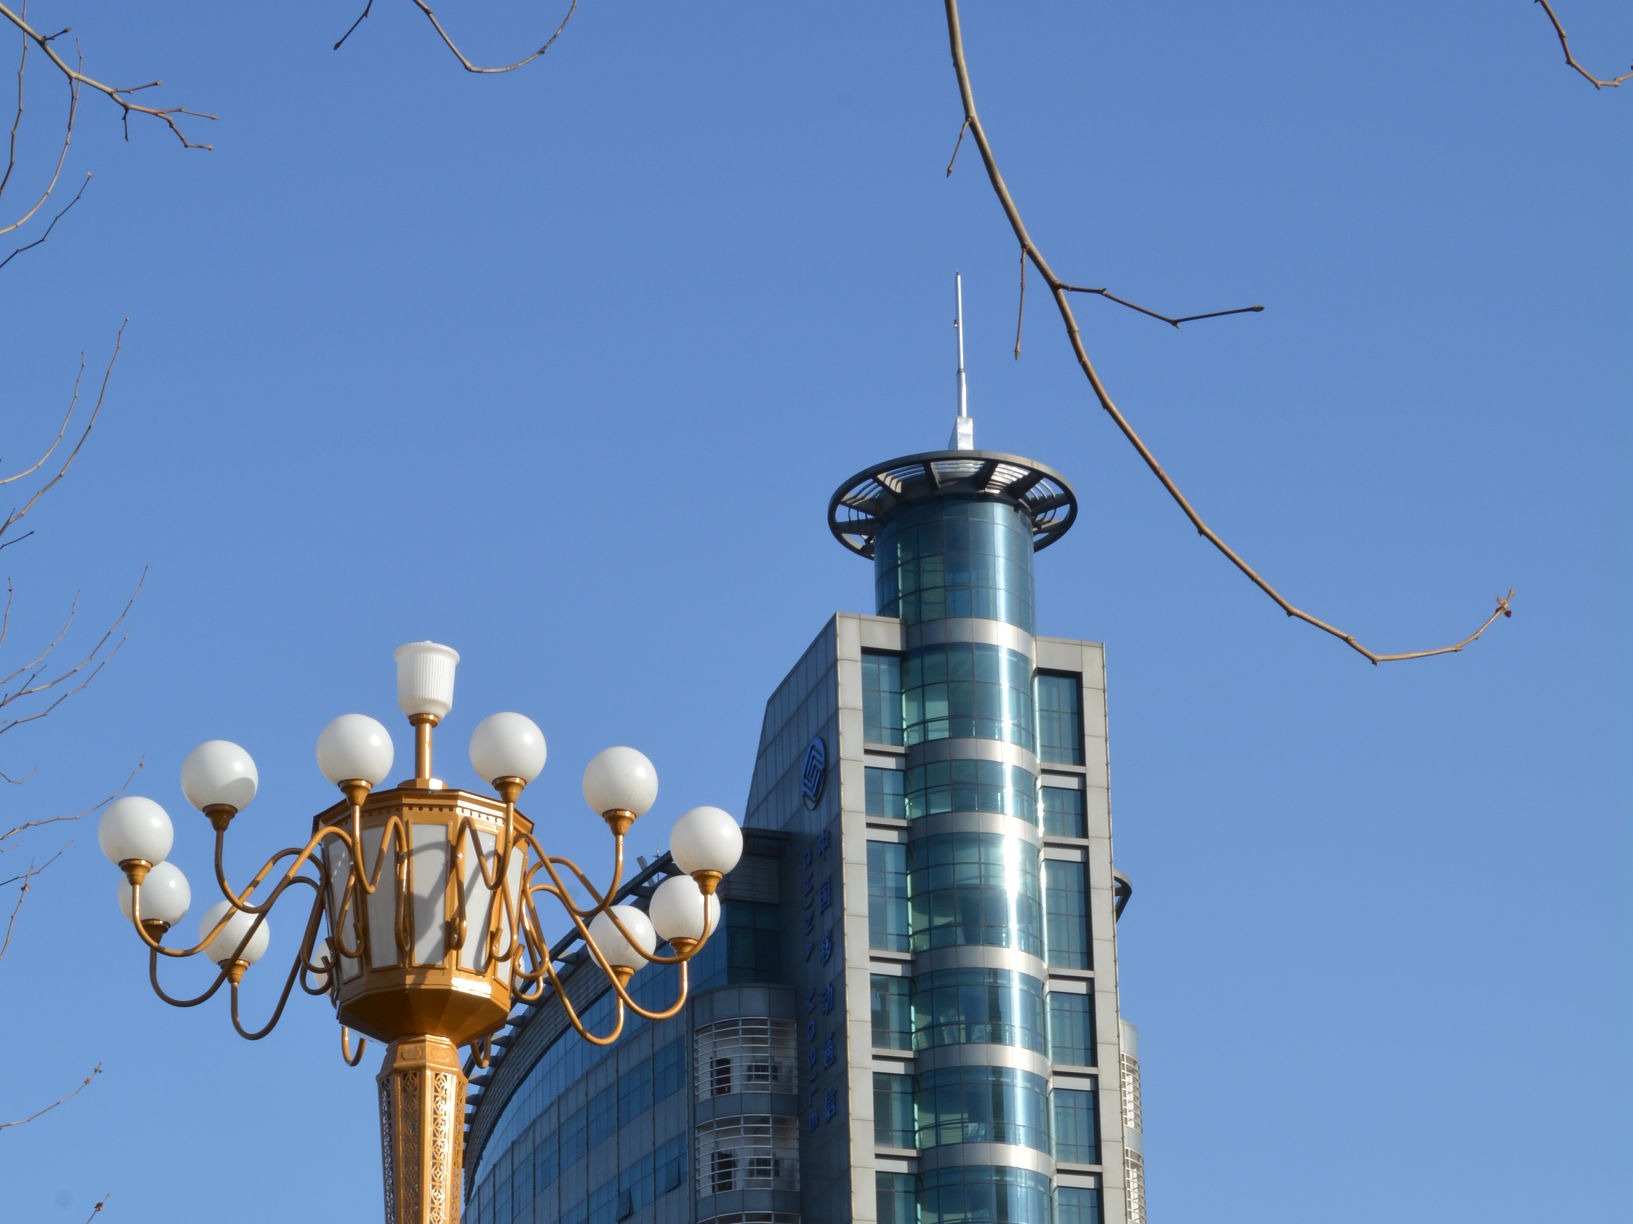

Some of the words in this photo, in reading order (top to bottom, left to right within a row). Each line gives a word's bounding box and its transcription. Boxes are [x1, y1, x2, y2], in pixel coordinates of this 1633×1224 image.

[802, 847, 815, 963] CHINA
[817, 829, 835, 1123] 中国移动通信
[806, 986, 818, 1134] MOBILE
